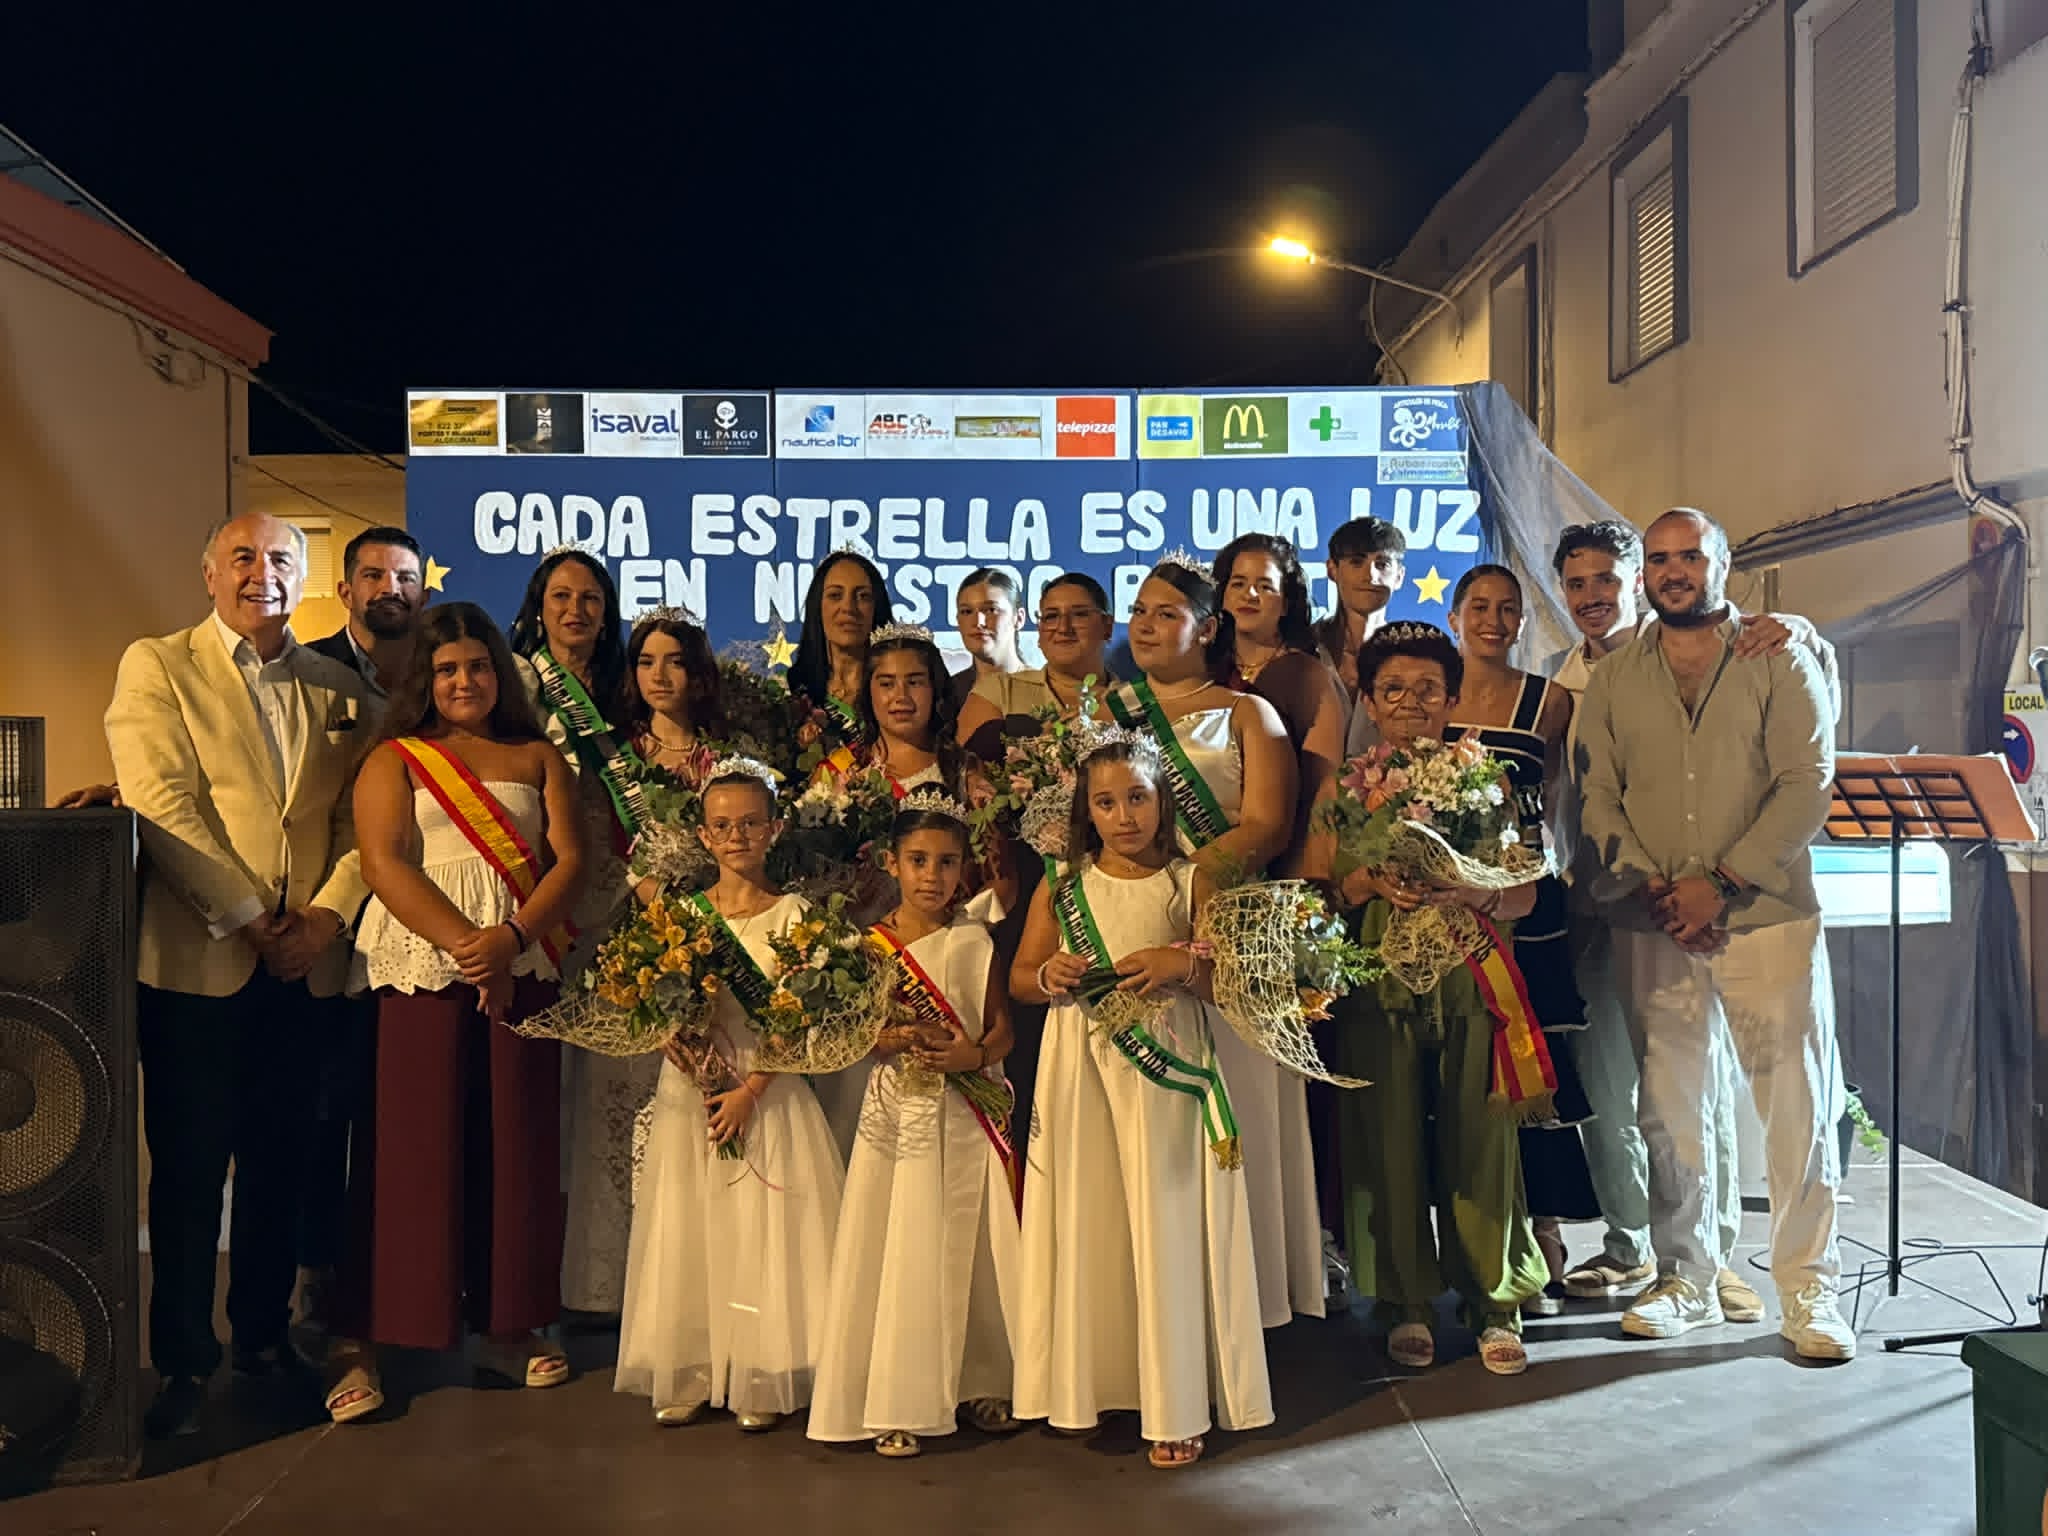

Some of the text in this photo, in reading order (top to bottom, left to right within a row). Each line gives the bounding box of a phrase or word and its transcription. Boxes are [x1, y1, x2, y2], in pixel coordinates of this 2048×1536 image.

[592, 408, 679, 433] isaval
[869, 414, 908, 429] ABC
[1057, 420, 1117, 437] telepizza
[695, 430, 758, 440] EL PARGO
[474, 491, 650, 557] CADA
[691, 493, 1050, 561] ESTRELLA
[1081, 492, 1167, 554] ES
[1192, 487, 1319, 550] UNA
[619, 559, 707, 622] EN
[2009, 695, 2043, 710] LOCAL
[1134, 1041, 1169, 1079] 2026
